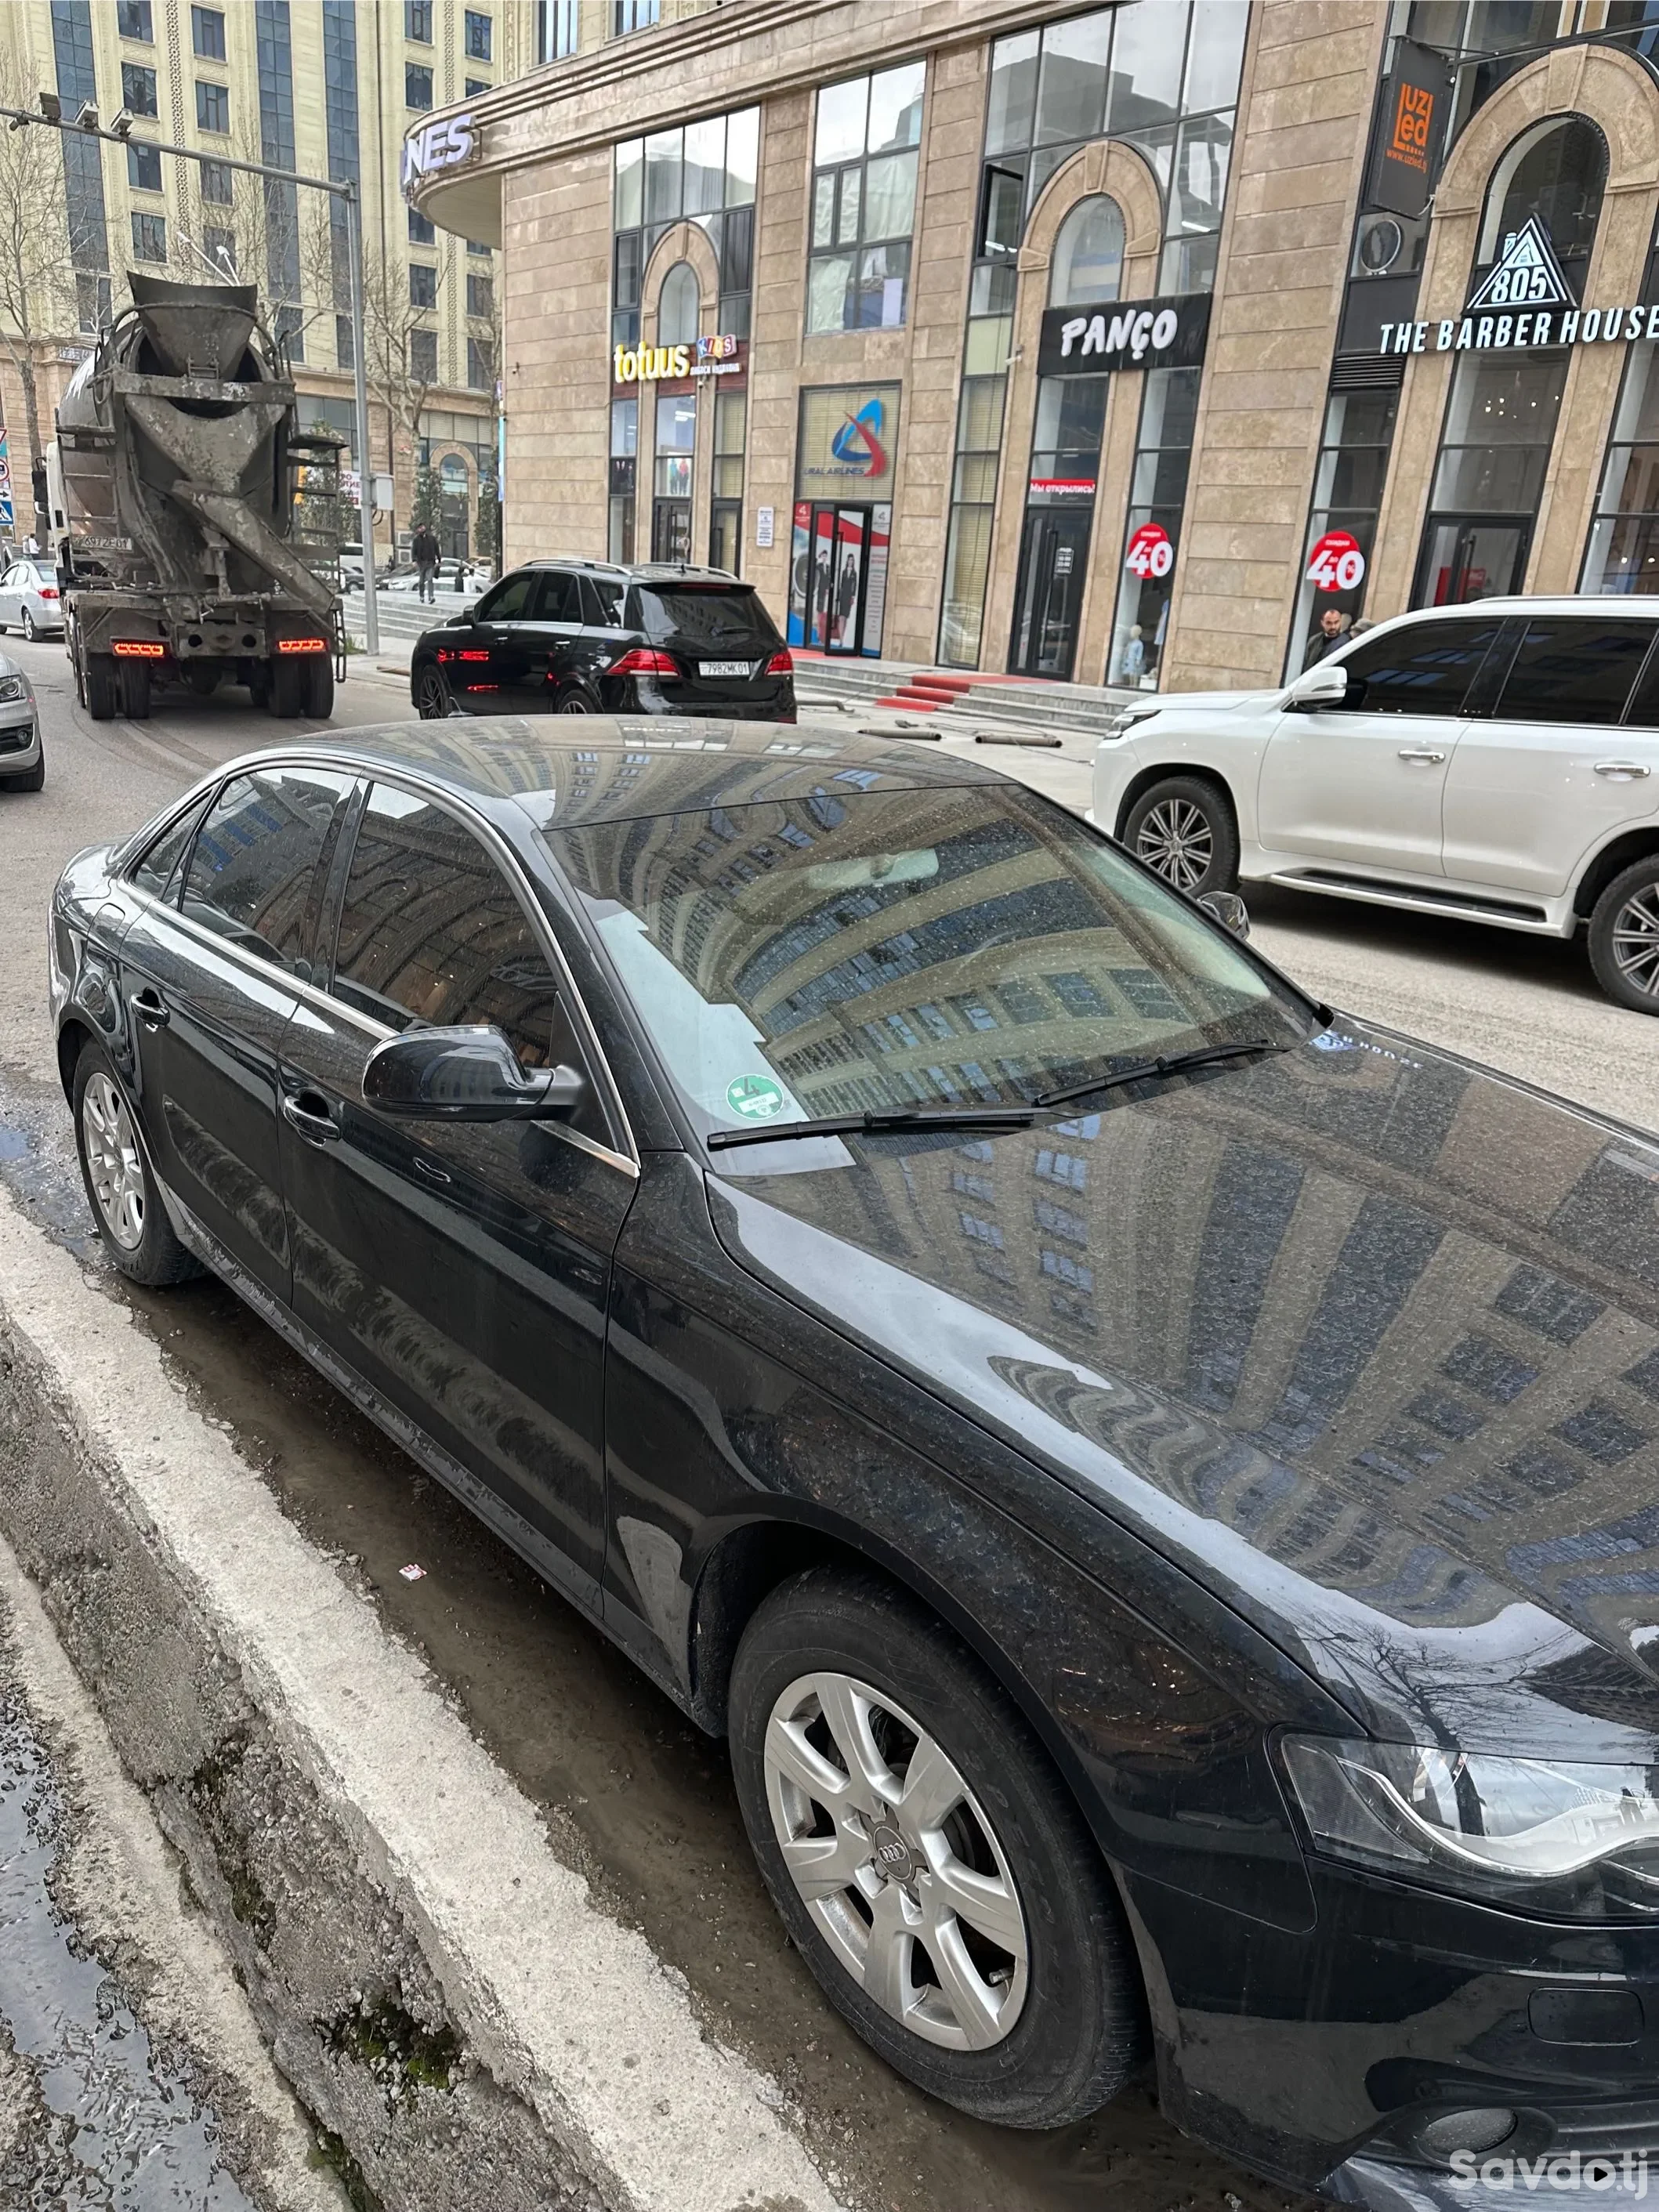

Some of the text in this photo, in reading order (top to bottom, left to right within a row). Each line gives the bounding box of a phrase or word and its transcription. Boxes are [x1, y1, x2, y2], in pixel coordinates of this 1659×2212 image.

[1491, 266, 1547, 303] 805
[697, 335, 736, 359] KIDS
[1061, 309, 1178, 360] PANÇO
[1379, 305, 1659, 354] THE BARBER HOUSE
[614, 340, 690, 383] totuus
[1126, 541, 1173, 577] 40
[1306, 549, 1365, 590] 40
[707, 662, 748, 675] 7982MK01
